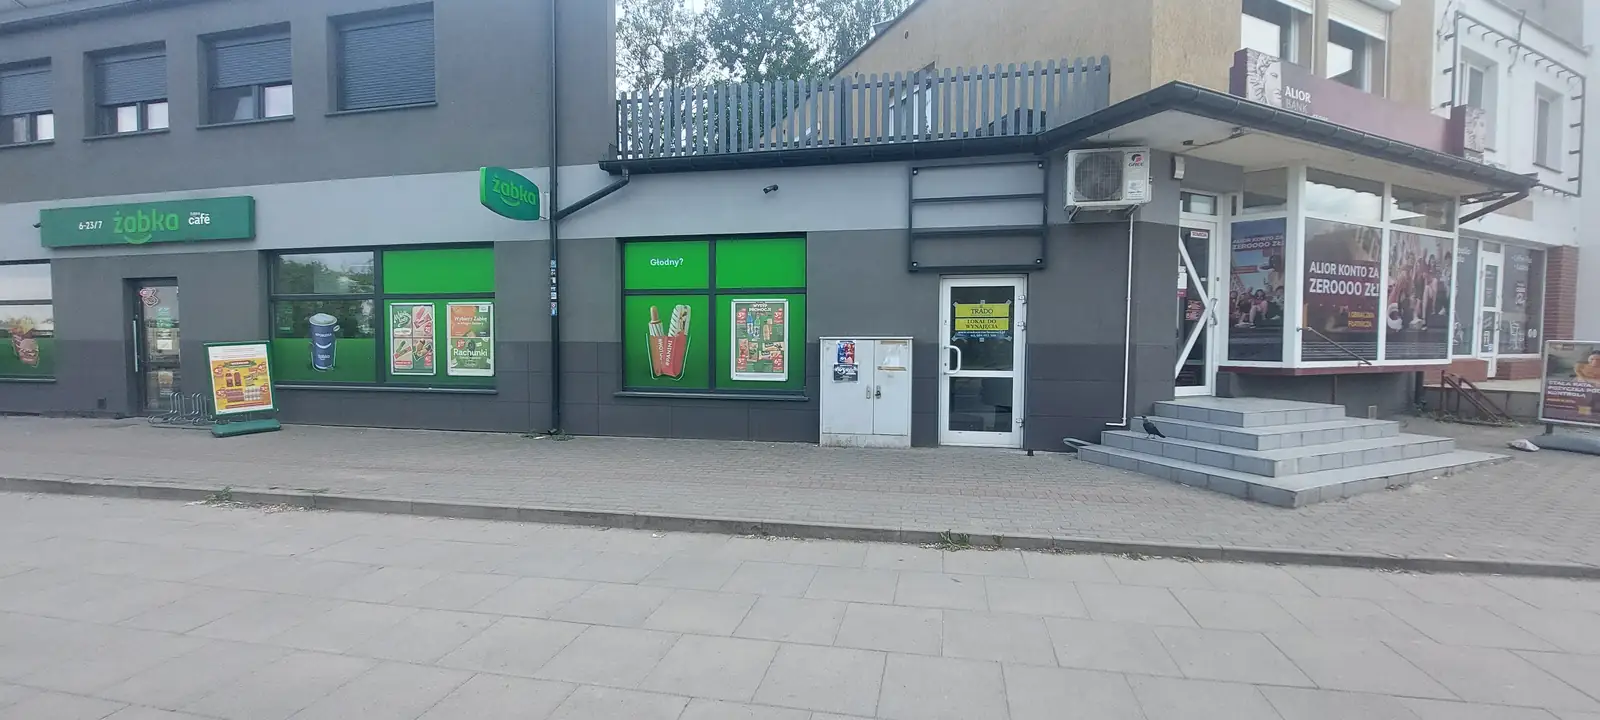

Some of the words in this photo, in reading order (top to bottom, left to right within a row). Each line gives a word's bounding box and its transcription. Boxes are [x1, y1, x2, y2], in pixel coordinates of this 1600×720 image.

[1285, 86, 1311, 103] ALIOR
[492, 173, 537, 205] żabka
[78, 220, 103, 230] 6-23/7
[113, 209, 179, 235] żabka
[650, 258, 684, 268] Głodny?
[1309, 261, 1337, 275] ALIOR
[1338, 264, 1367, 277] KONTO
[1368, 267, 1379, 279] ZA
[1364, 282, 1380, 297] ZŁ!
[453, 348, 488, 357] Rachunki
